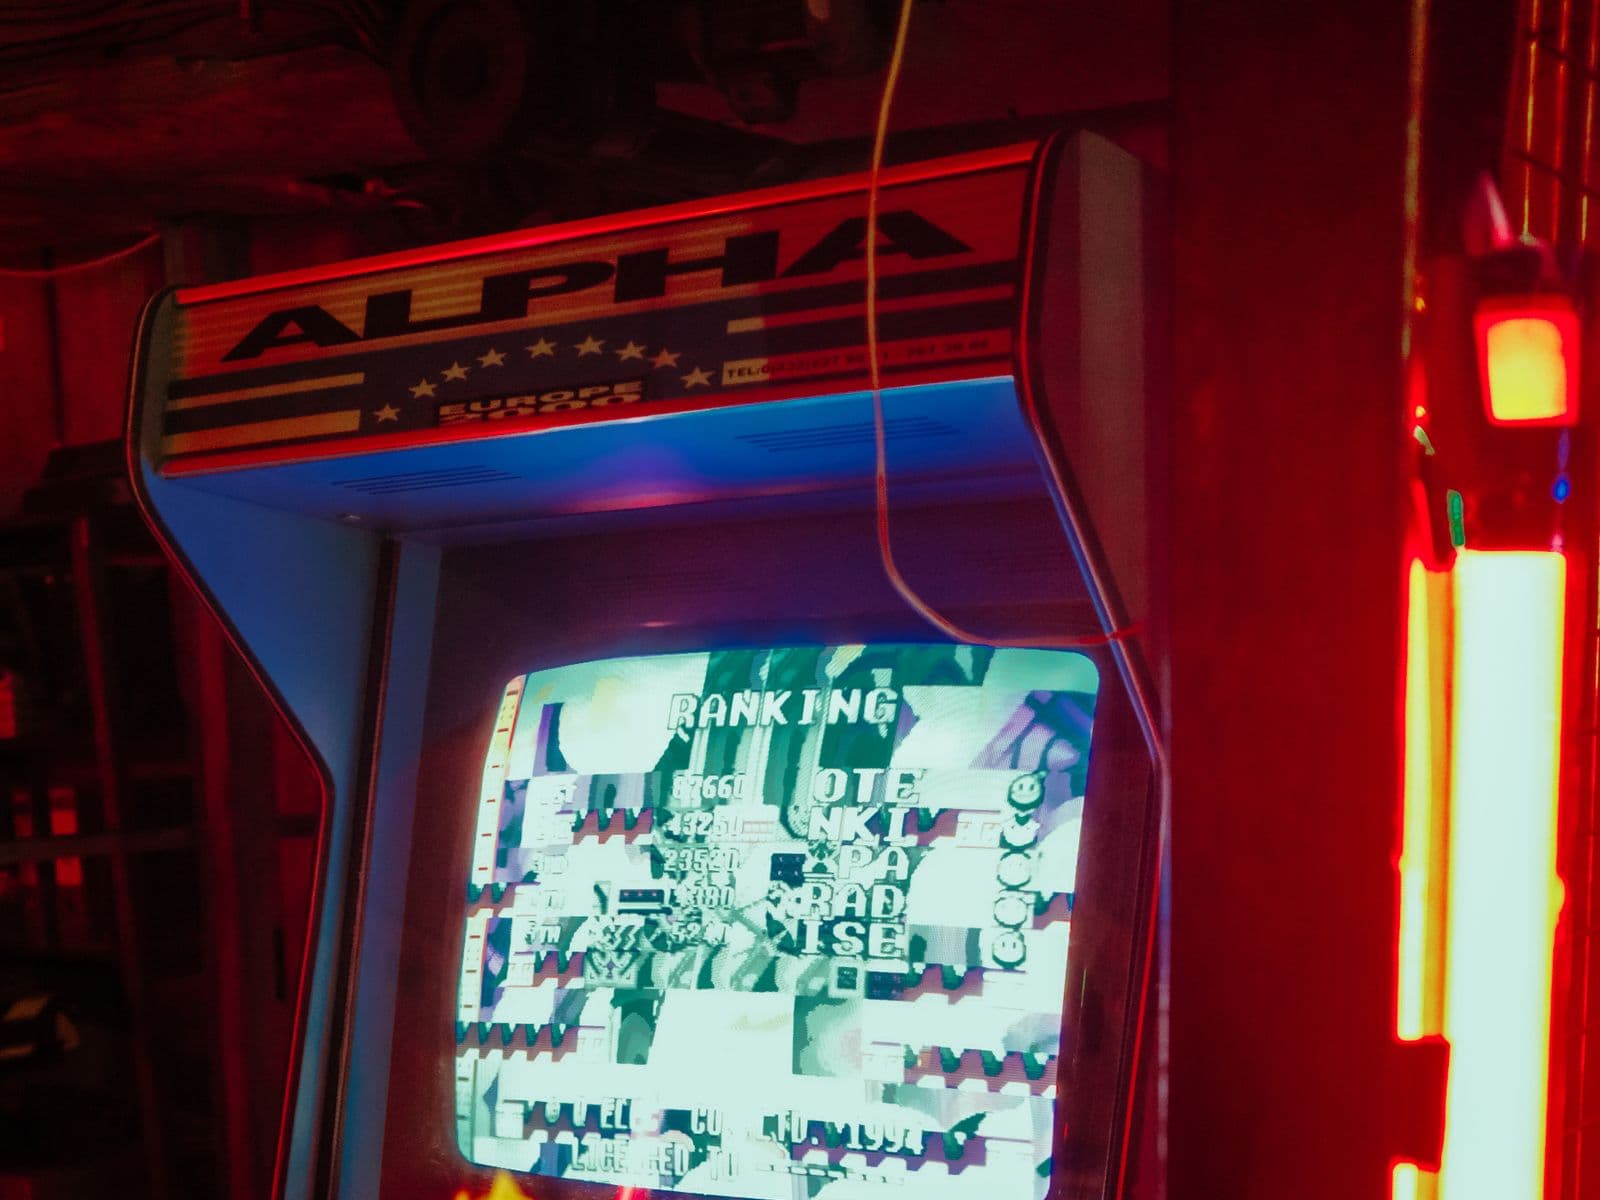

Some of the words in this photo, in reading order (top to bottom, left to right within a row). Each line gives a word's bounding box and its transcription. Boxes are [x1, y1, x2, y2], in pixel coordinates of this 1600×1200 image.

[220, 208, 976, 363] ALPHA
[439, 380, 643, 417] EUROPE
[668, 687, 898, 730] RANKING
[813, 767, 924, 804] OTE
[808, 804, 918, 846] NKI
[804, 881, 907, 920] RAD
[802, 919, 906, 958] ISE
